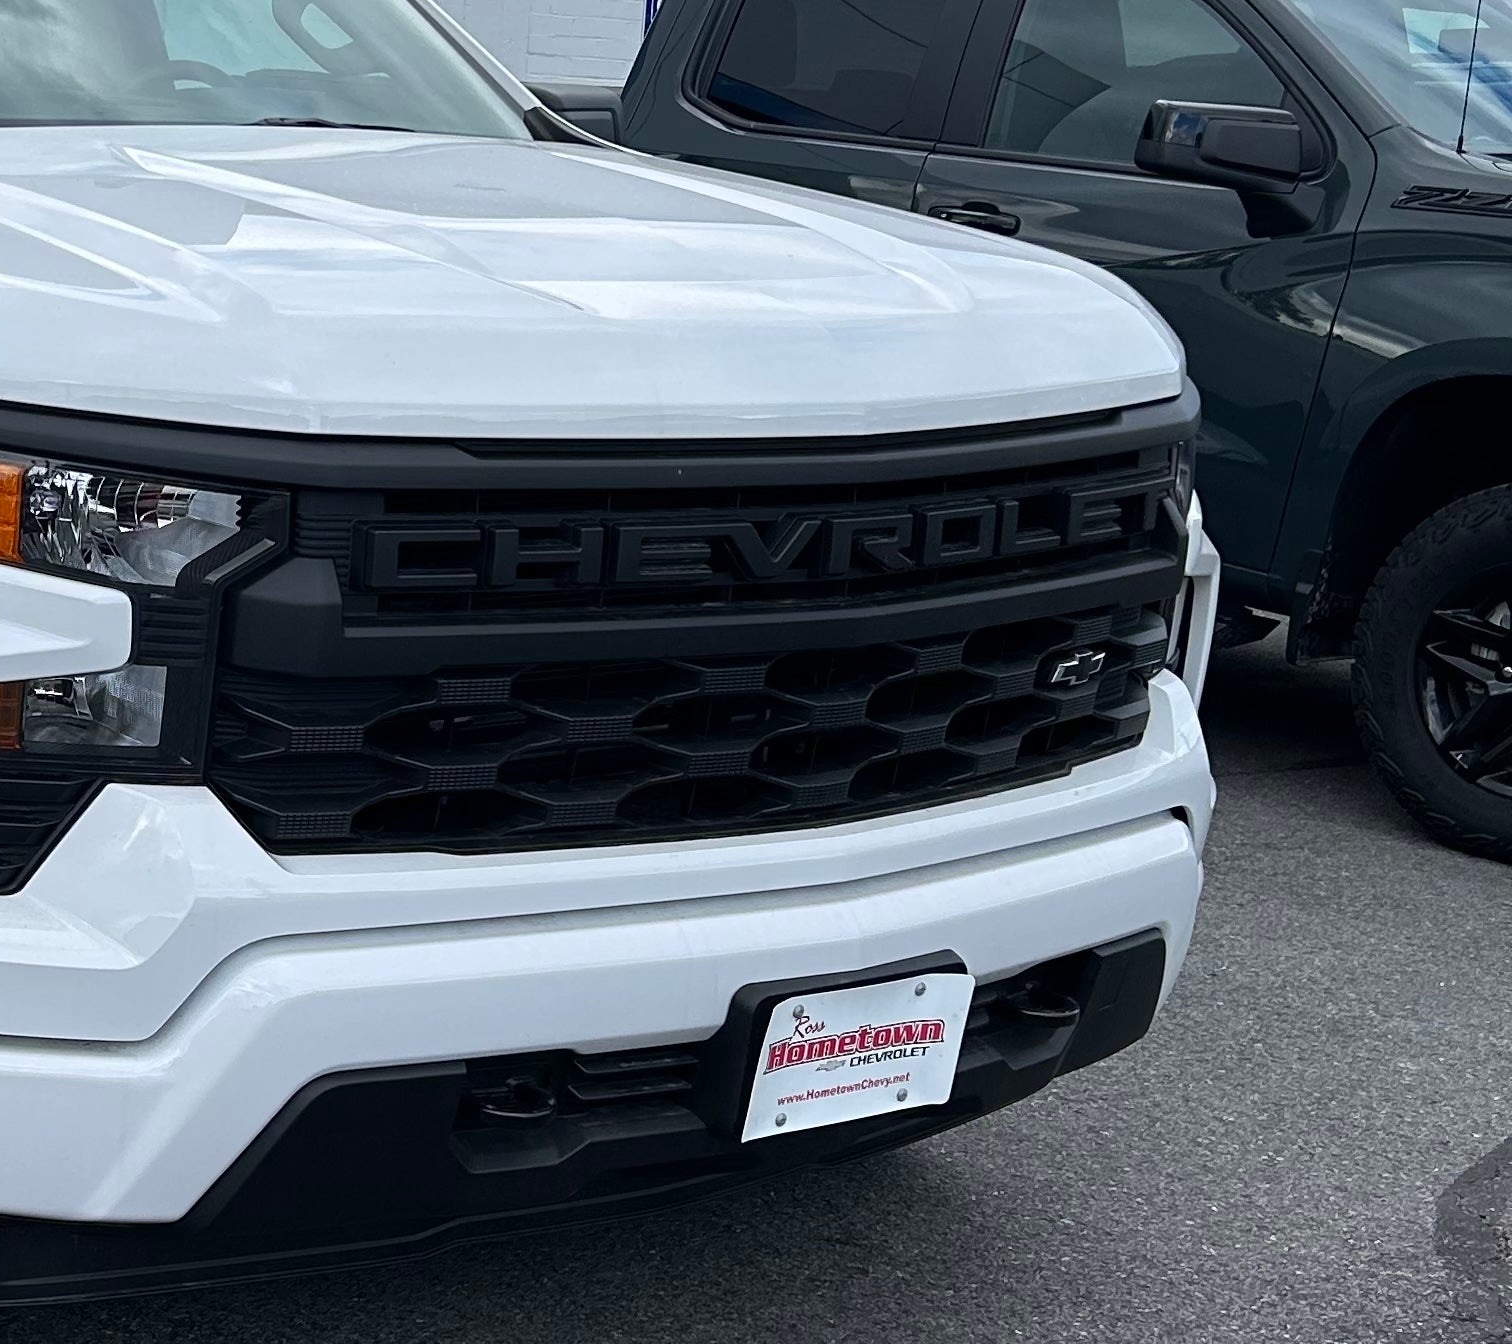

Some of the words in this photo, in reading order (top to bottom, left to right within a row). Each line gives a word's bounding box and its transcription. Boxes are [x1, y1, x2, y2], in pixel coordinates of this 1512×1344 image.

[1389, 184, 1512, 219] Z7
[352, 474, 1176, 589] CHEVROLET
[790, 1015, 826, 1039] Ross
[763, 1019, 945, 1074] Hometown
[849, 1046, 930, 1067] CHEVROLET
[777, 1072, 911, 1106] www.HometownChevy.net
